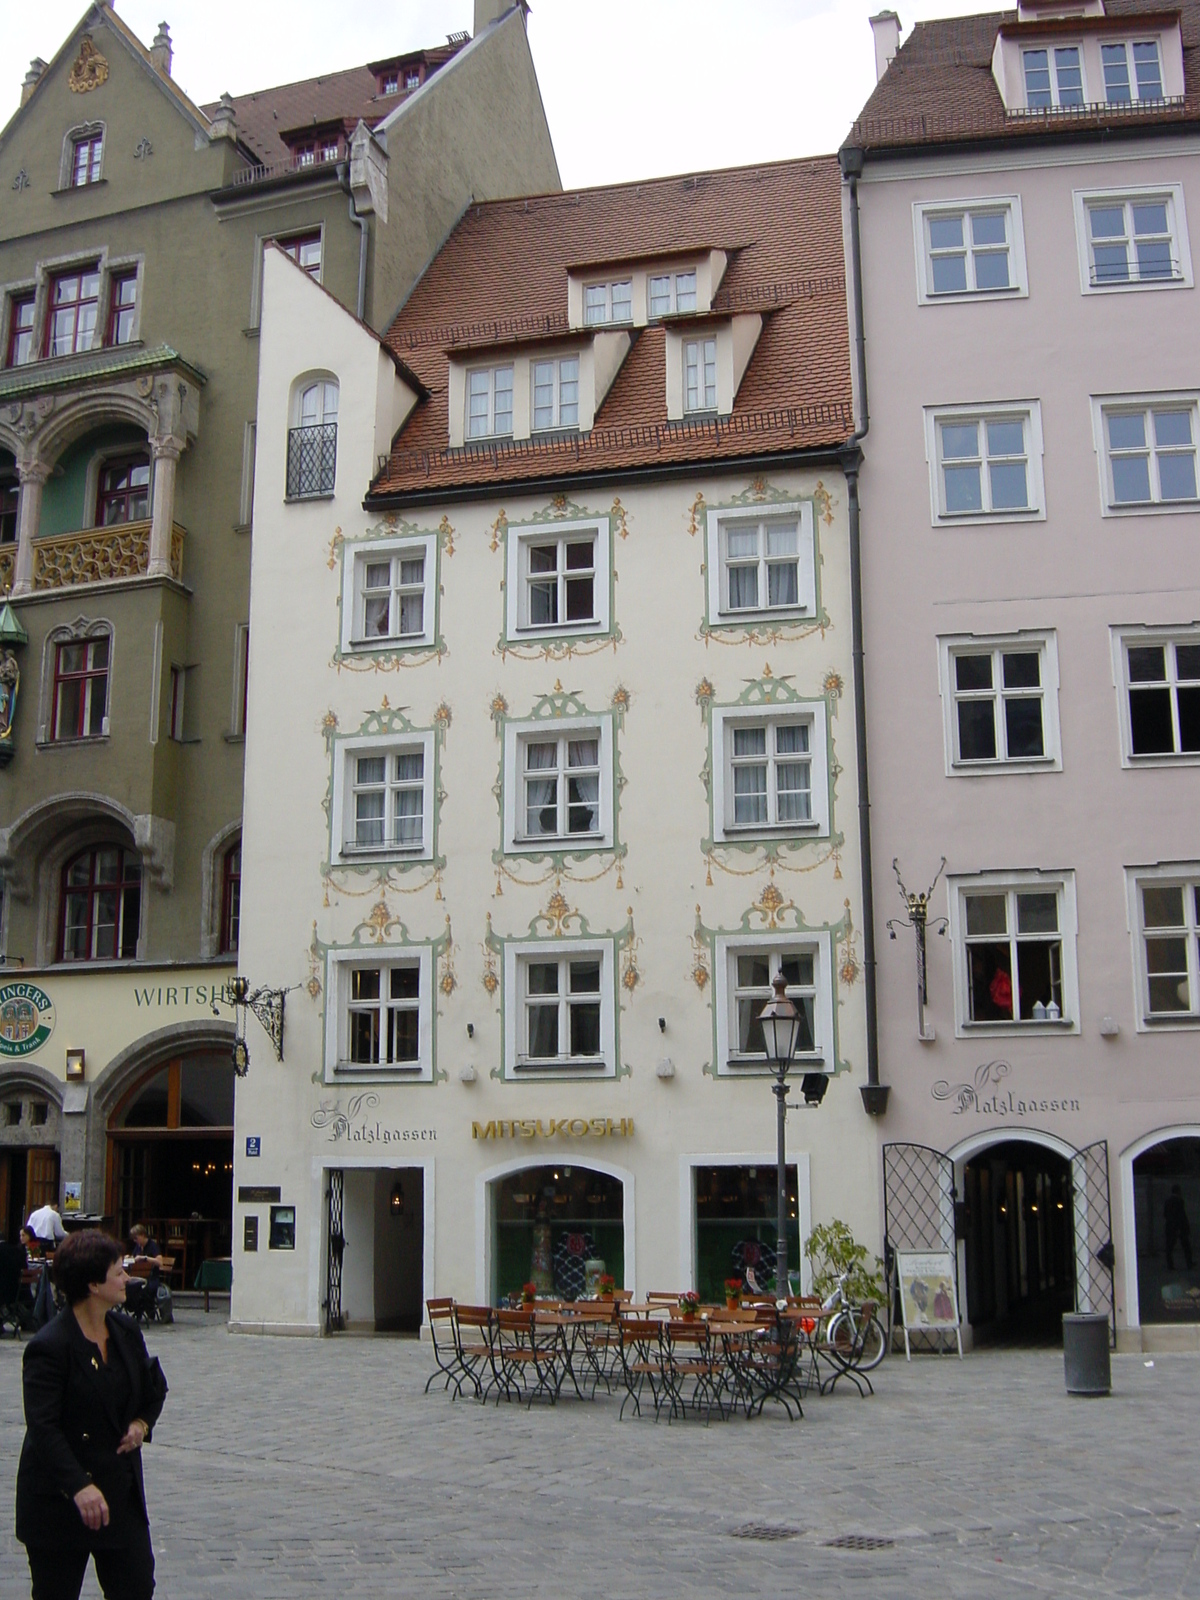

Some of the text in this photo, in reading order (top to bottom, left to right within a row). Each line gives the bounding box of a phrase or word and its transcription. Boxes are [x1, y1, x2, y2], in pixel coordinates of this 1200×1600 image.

[0, 984, 48, 1010] INGERS
[931, 1078, 1080, 1116] Platzlgassen
[311, 1107, 437, 1144] Platzlgassen
[472, 1117, 635, 1139] MITSUKOSHI
[249, 1138, 257, 1148] 2
